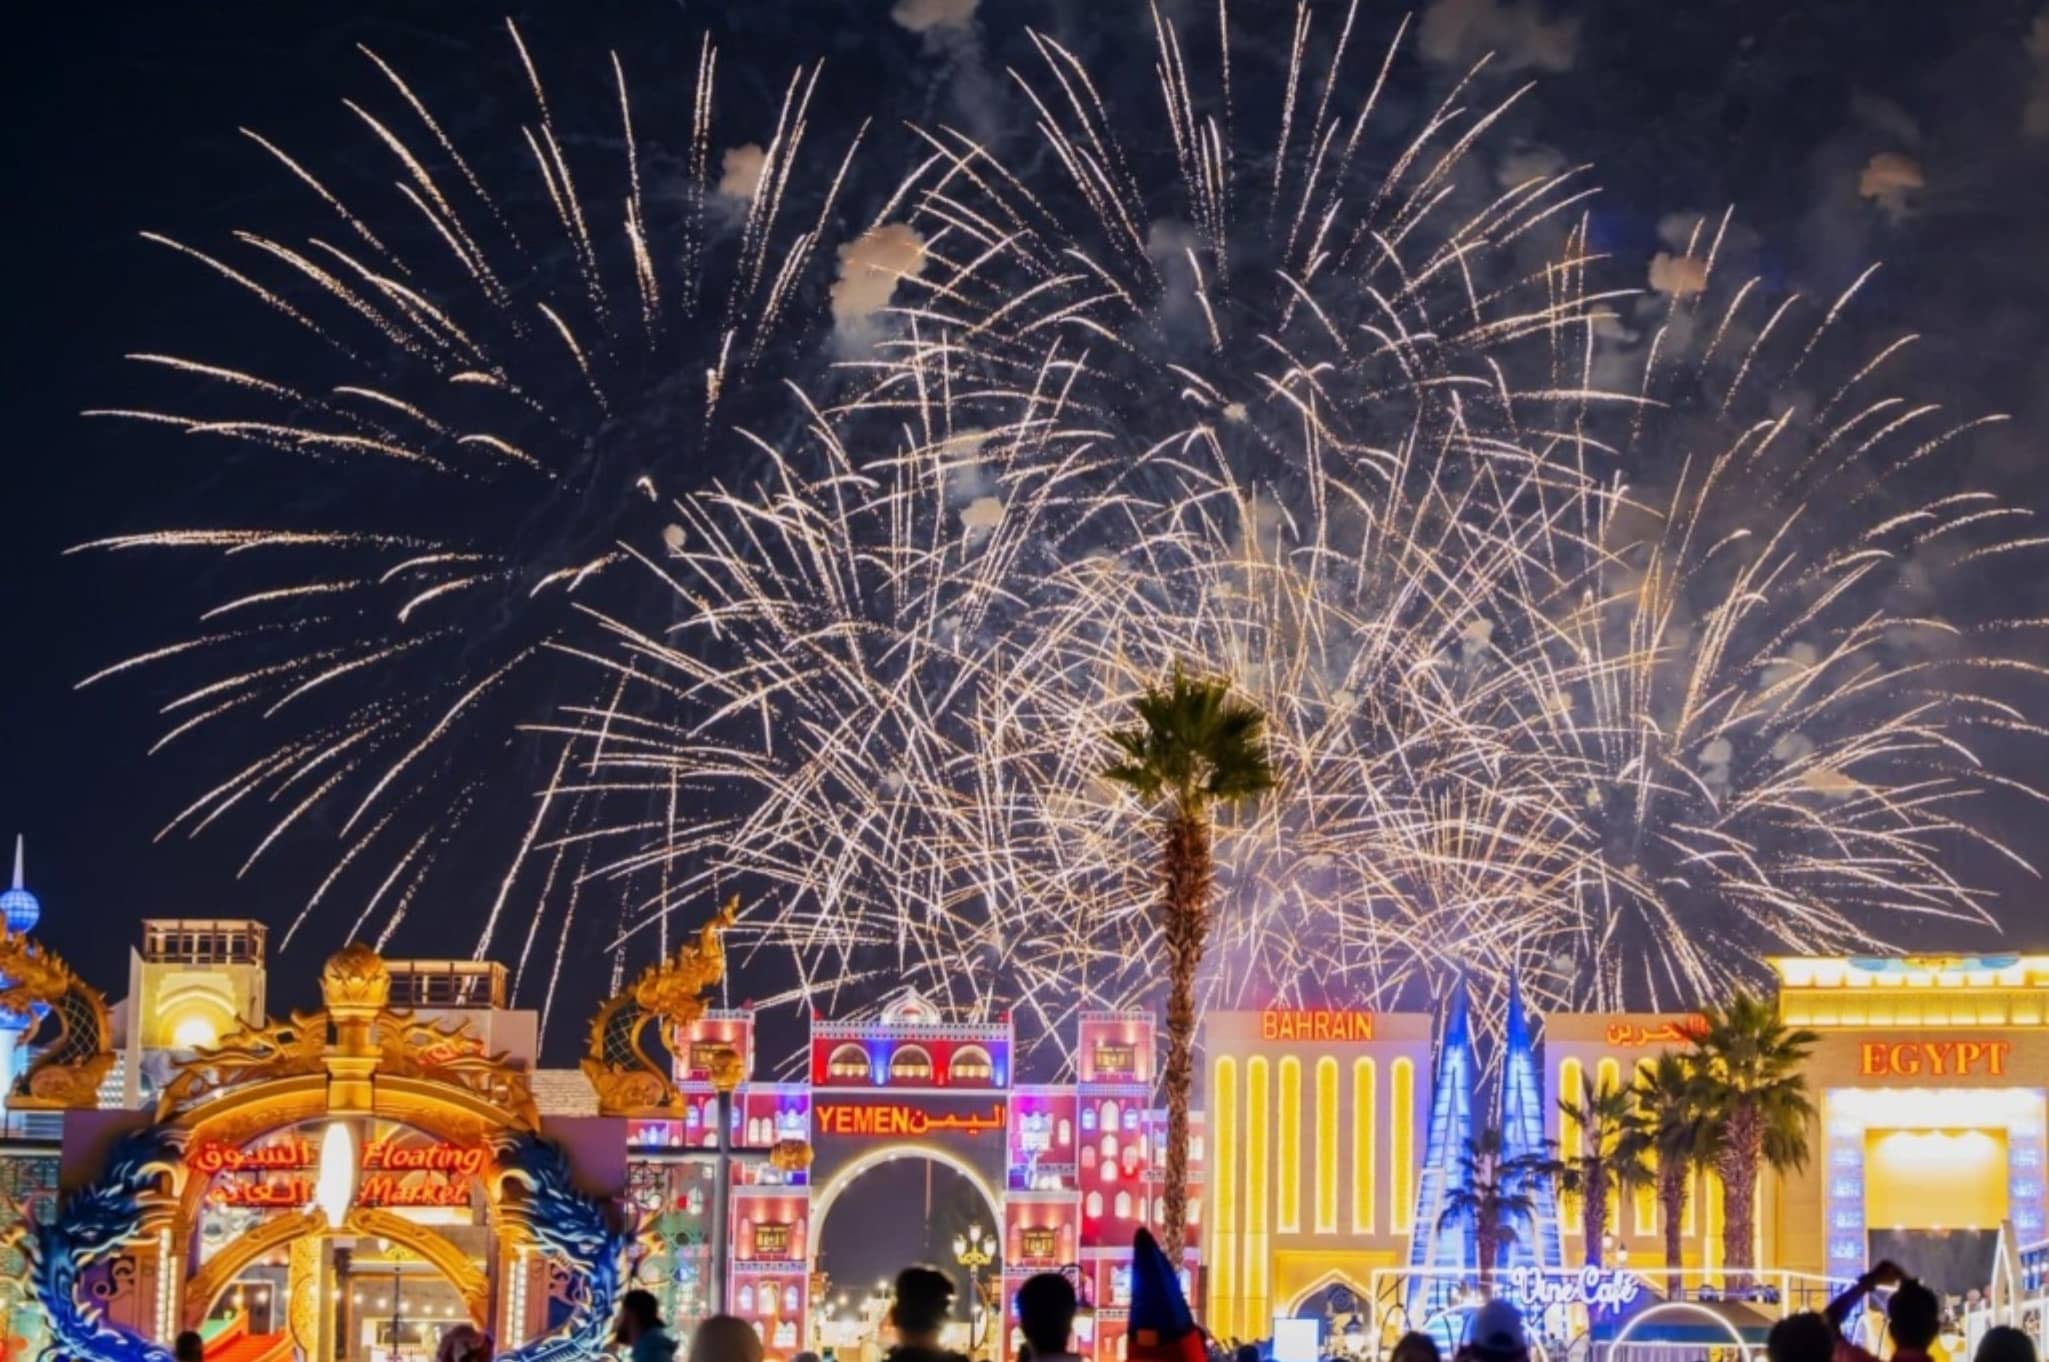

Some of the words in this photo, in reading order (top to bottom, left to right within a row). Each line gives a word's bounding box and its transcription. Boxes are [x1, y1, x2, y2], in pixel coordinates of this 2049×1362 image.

[1262, 1010, 1373, 1041] BAHRAIN
[1861, 1042, 2010, 1075] EGYPT
[816, 1105, 909, 1133] YEMEN
[910, 1104, 1006, 1135] اليمن
[197, 1141, 311, 1172] السوق
[362, 1142, 484, 1173] Floating
[358, 1176, 468, 1204] Market
